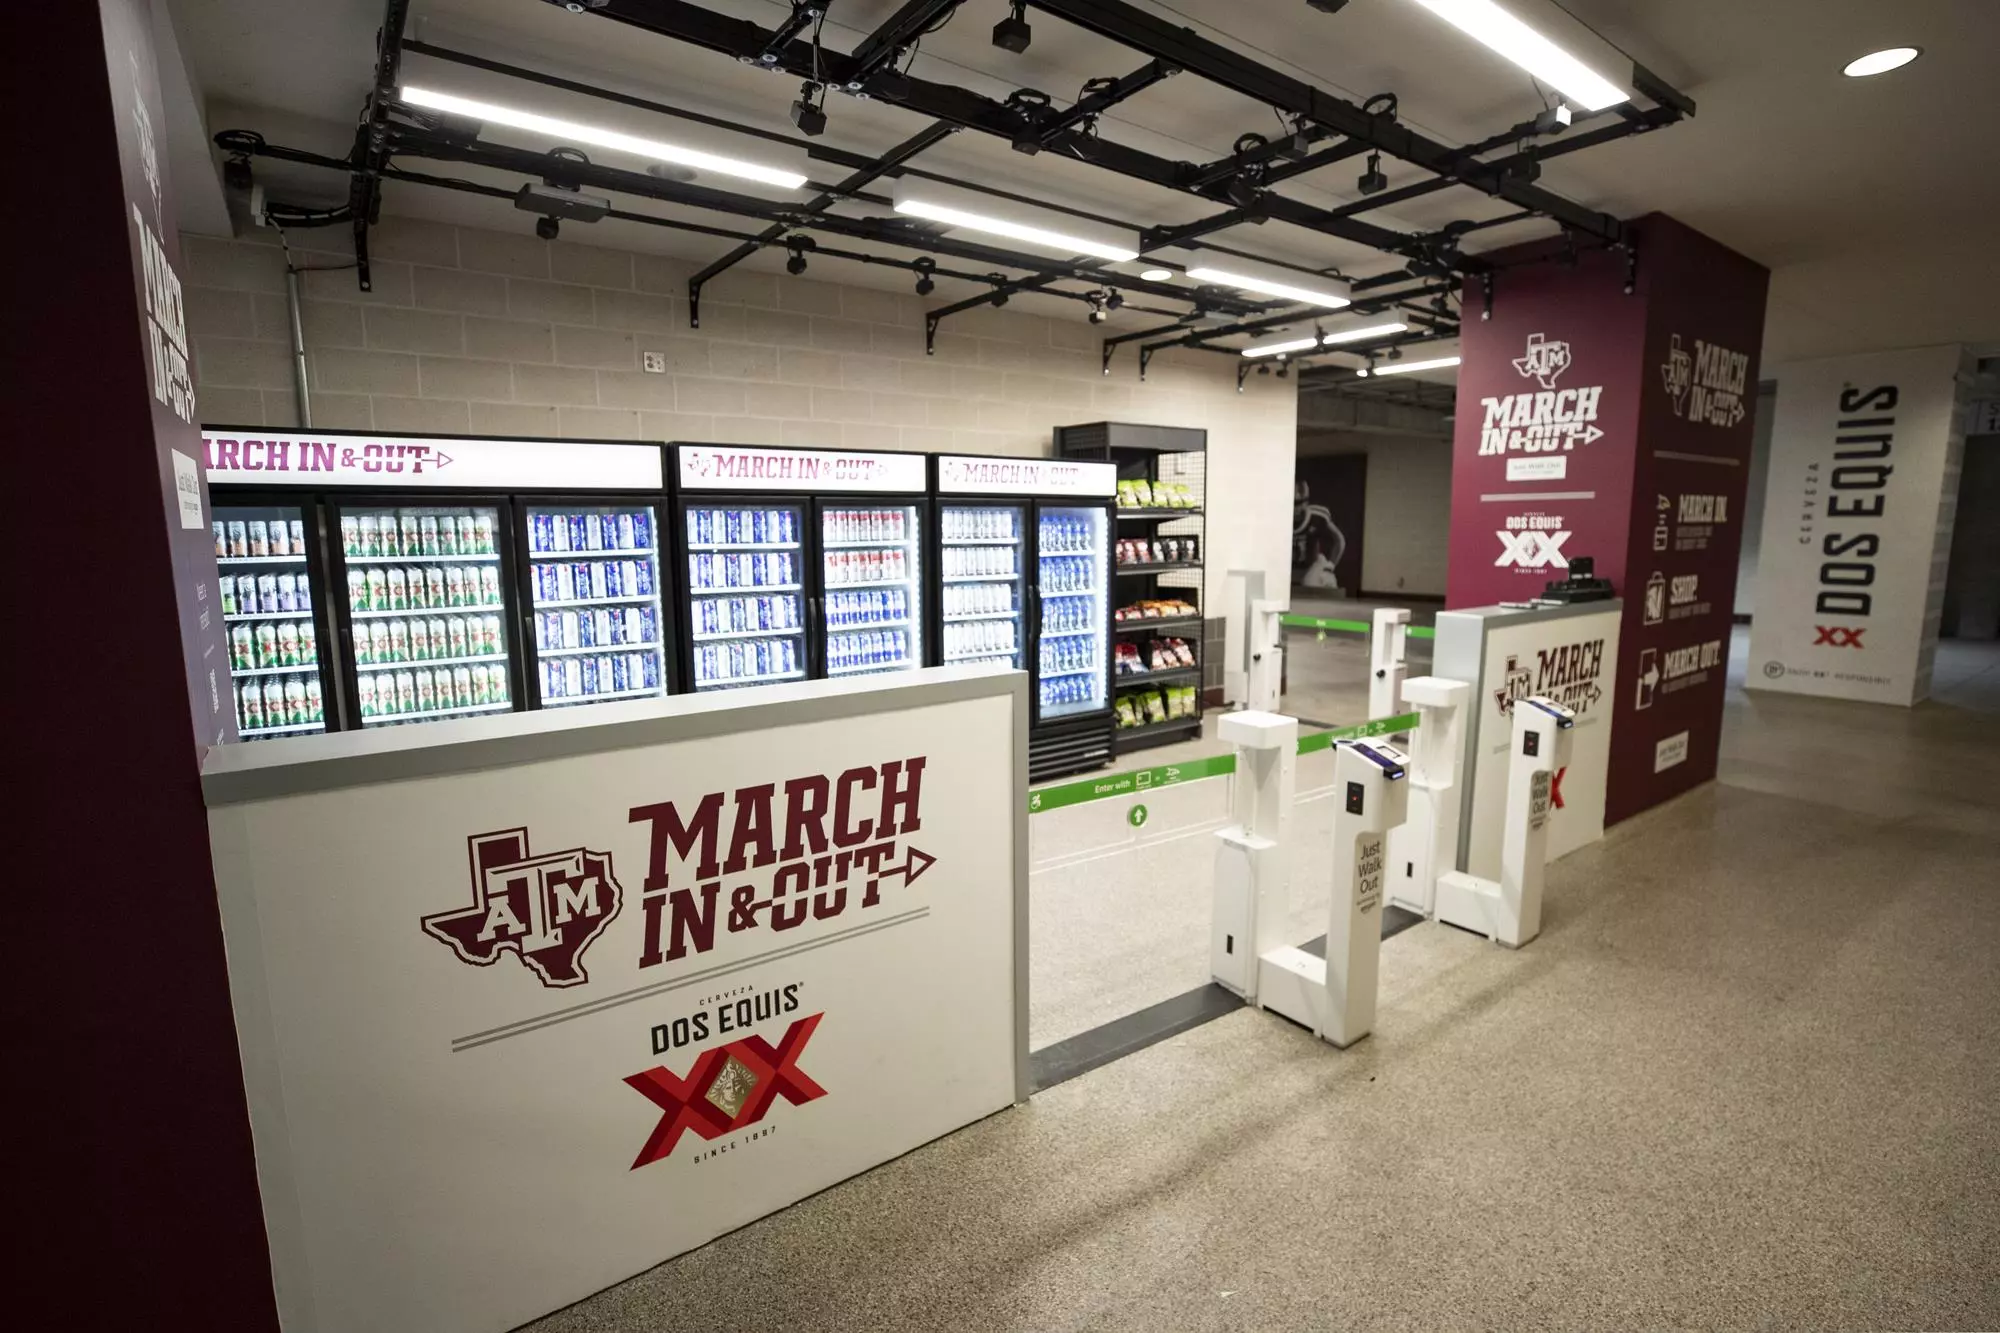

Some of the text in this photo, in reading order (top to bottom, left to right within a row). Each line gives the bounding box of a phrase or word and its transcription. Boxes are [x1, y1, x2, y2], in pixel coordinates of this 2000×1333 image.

[132, 202, 189, 360] MARCH
[1694, 339, 1749, 396] MARCH
[1480, 386, 1603, 430] MARCH
[1688, 384, 1708, 422] IN
[1710, 390, 1738, 428] OUT
[298, 443, 336, 472] IN
[341, 448, 356, 468] &
[363, 444, 430, 474] OUT
[1477, 422, 1584, 457] IN & OUT
[1827, 384, 1899, 518] EQUIS
[711, 454, 875, 481] MARCH IN & OUT
[963, 463, 1016, 484] MARCH
[1017, 465, 1040, 485] IN
[1050, 466, 1081, 486] OUT
[1678, 494, 1714, 523] MARCH
[1494, 530, 1573, 568] XX
[1815, 532, 1880, 617] DOS
[1812, 625, 1868, 650] XX
[1537, 639, 1605, 691] MARCH
[1662, 644, 1700, 681] MARCH
[1094, 782, 1115, 794] Enter
[1114, 780, 1131, 791] with
[628, 756, 927, 893] MARCH
[1357, 858, 1383, 878] Walk
[1360, 840, 1382, 861] Just
[1359, 877, 1379, 895] Out
[639, 841, 896, 970] IN & OUT
[699, 985, 755, 1006] CERVEZA
[651, 982, 801, 1055] DOS EQUIS
[622, 1012, 829, 1172] XX
[694, 1125, 777, 1164] SINCE 1897
